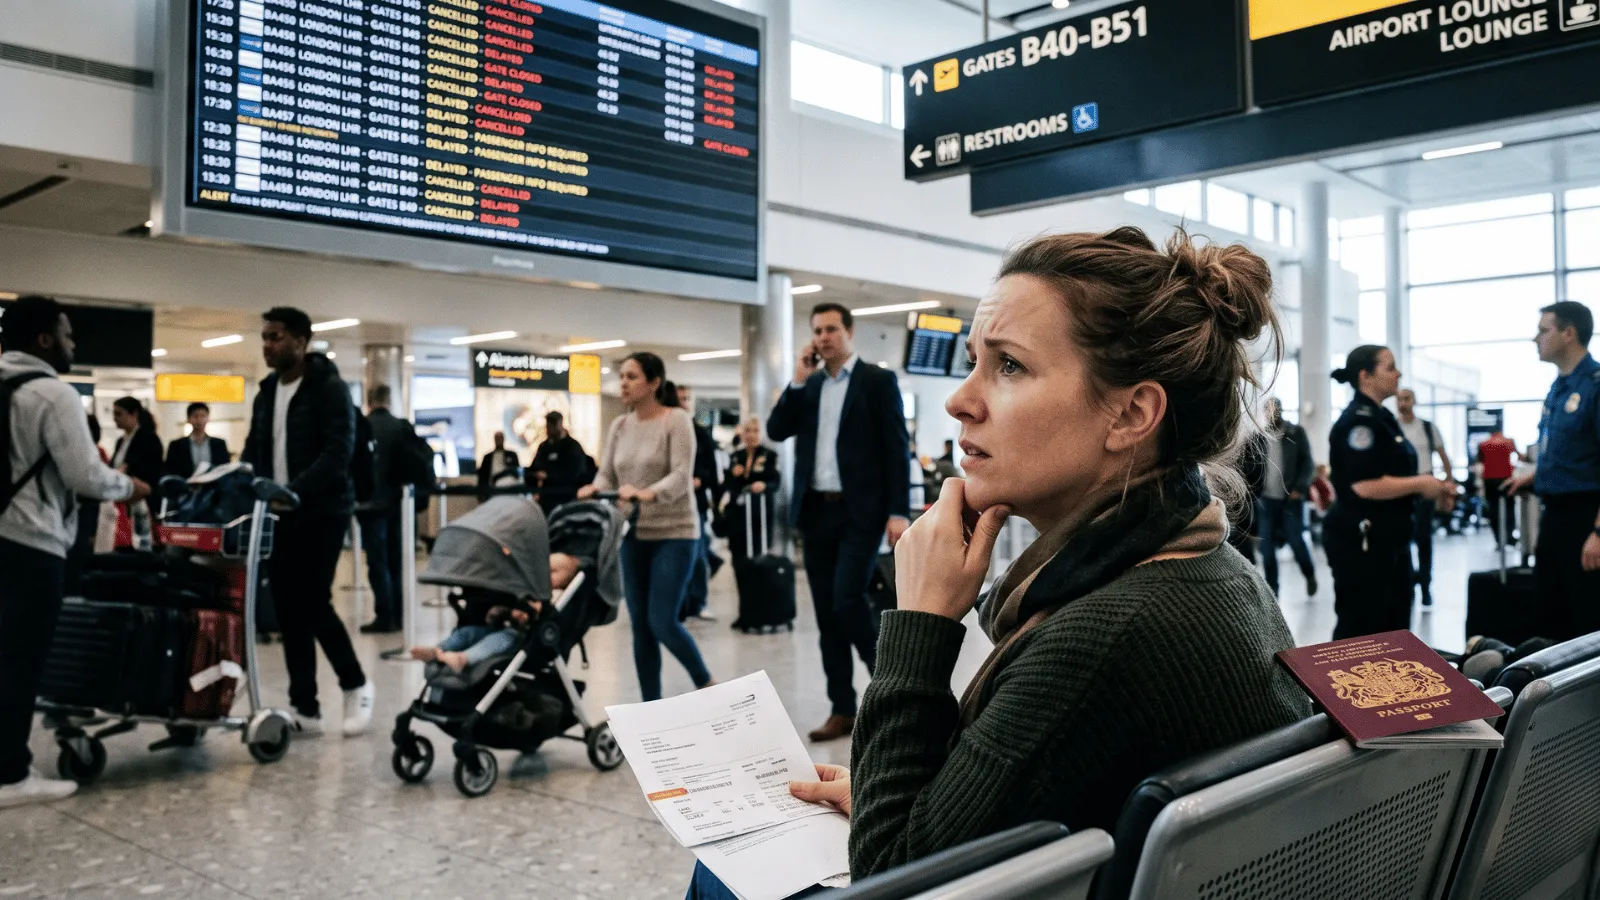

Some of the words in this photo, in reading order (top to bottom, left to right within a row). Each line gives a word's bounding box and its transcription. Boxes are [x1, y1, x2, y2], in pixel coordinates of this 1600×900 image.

[299, 2, 342, 21] LONDON
[370, 19, 401, 35] GATES
[427, 34, 478, 54] CANCELLED
[370, 4, 402, 20] GATES
[427, 19, 478, 39] CANCELLED
[484, 34, 533, 53] CANCELLED
[428, 4, 478, 25] CANCELLED
[485, 19, 533, 39] CANCELLED
[485, 5, 534, 25] CANCELLED
[1329, 8, 1432, 51] AIRPORT
[1440, 9, 1548, 52] LOUNGE
[298, 33, 341, 52] LONDON
[369, 50, 401, 65] GATES
[427, 63, 478, 83] CANCELLED
[299, 17, 342, 37] LONDON
[369, 34, 401, 50] GATES
[427, 48, 478, 68] CANCELLED
[962, 47, 1016, 77] GATES
[1021, 5, 1147, 67] B40-B51
[298, 49, 341, 68] LONDON
[369, 65, 400, 81] GATES
[427, 78, 478, 97] CANCELLED
[298, 65, 341, 83] LONDON
[369, 80, 400, 96] GATES
[426, 93, 468, 110] DELAYED
[297, 81, 341, 99] LONDON
[368, 96, 400, 111] GATES
[426, 108, 468, 125] DELAYED
[475, 118, 524, 136] CANCELLED
[297, 97, 341, 115] LONDON
[368, 111, 400, 127] GATES
[426, 123, 468, 139] DELAYED
[474, 132, 525, 150] PASSENGER
[297, 113, 340, 131] LONDON
[368, 127, 400, 142] GATES
[426, 137, 468, 154] DELAYED
[963, 113, 1068, 153] RESTROOMS
[296, 137, 340, 154] LONDON
[368, 149, 399, 164] GATES
[425, 159, 467, 175] DELAYED
[296, 153, 340, 170] LONDON
[367, 165, 399, 179] GATES
[425, 175, 474, 191] CANCELLED
[480, 184, 531, 200] CANCELLED
[200, 189, 229, 201] ALERT
[295, 185, 339, 201] LONDON
[367, 196, 398, 210] GATES
[424, 204, 474, 221] CANCELLED
[296, 169, 339, 185] LONDON
[367, 180, 399, 194] GATES
[424, 189, 474, 206] CANCELLED
[489, 353, 529, 370] Airport
[530, 356, 568, 374] Lounge
[1376, 699, 1452, 717] PASSPORT
